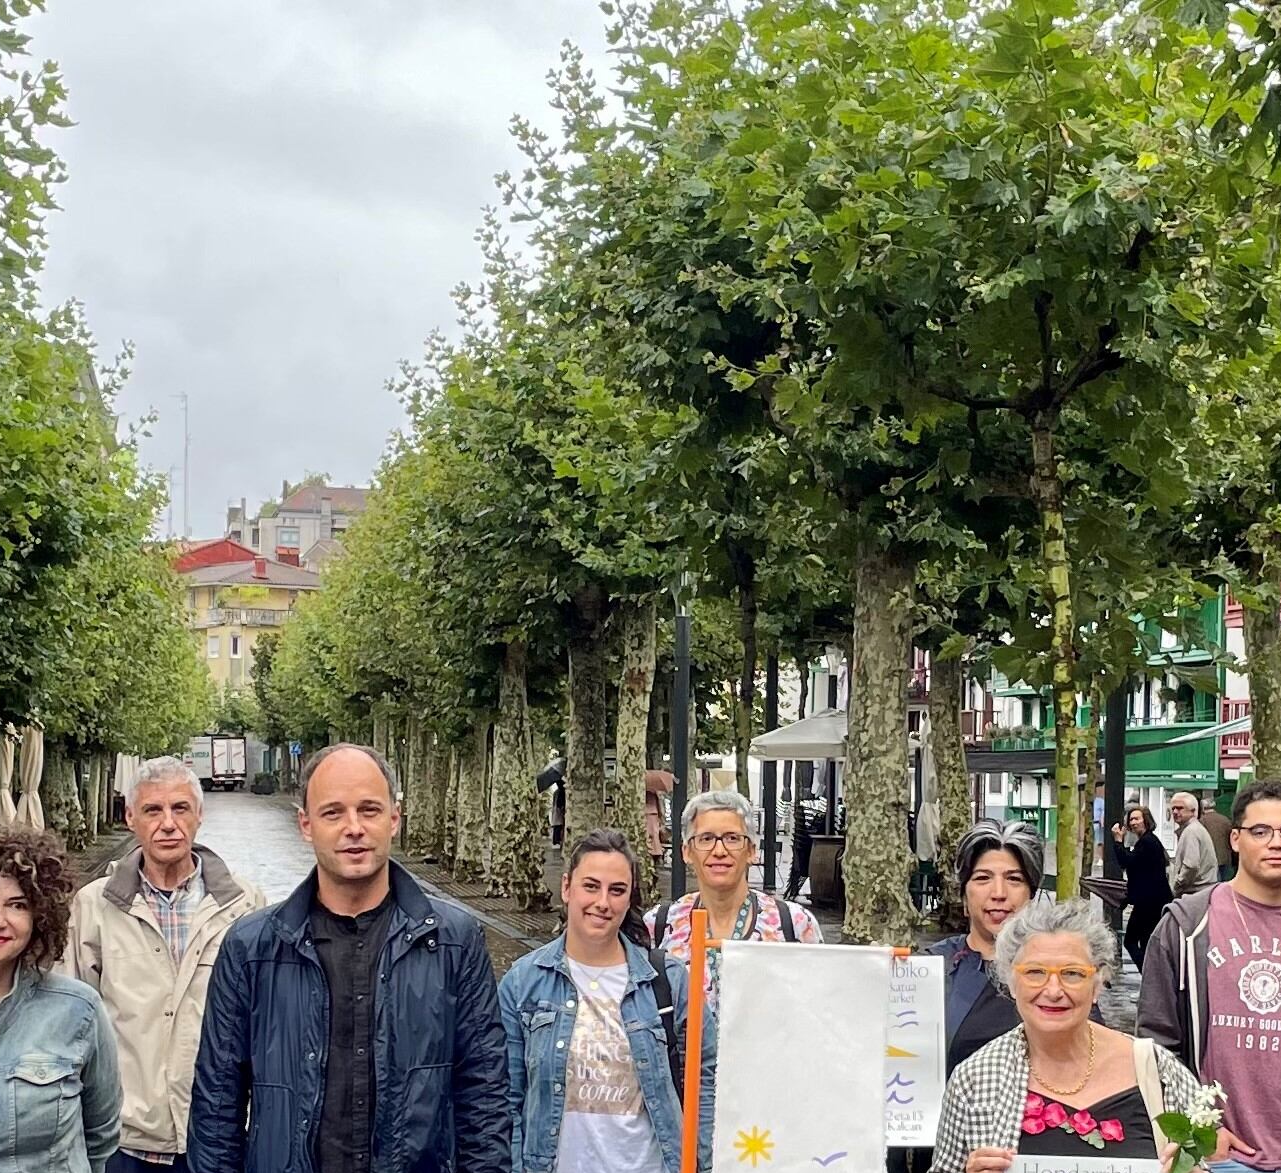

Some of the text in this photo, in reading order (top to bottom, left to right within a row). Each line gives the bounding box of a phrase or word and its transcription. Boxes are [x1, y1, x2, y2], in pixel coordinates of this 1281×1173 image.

[1212, 1015, 1254, 1029] LUXURY
[1236, 1034, 1280, 1052] 1982
[578, 1082, 629, 1103] come
